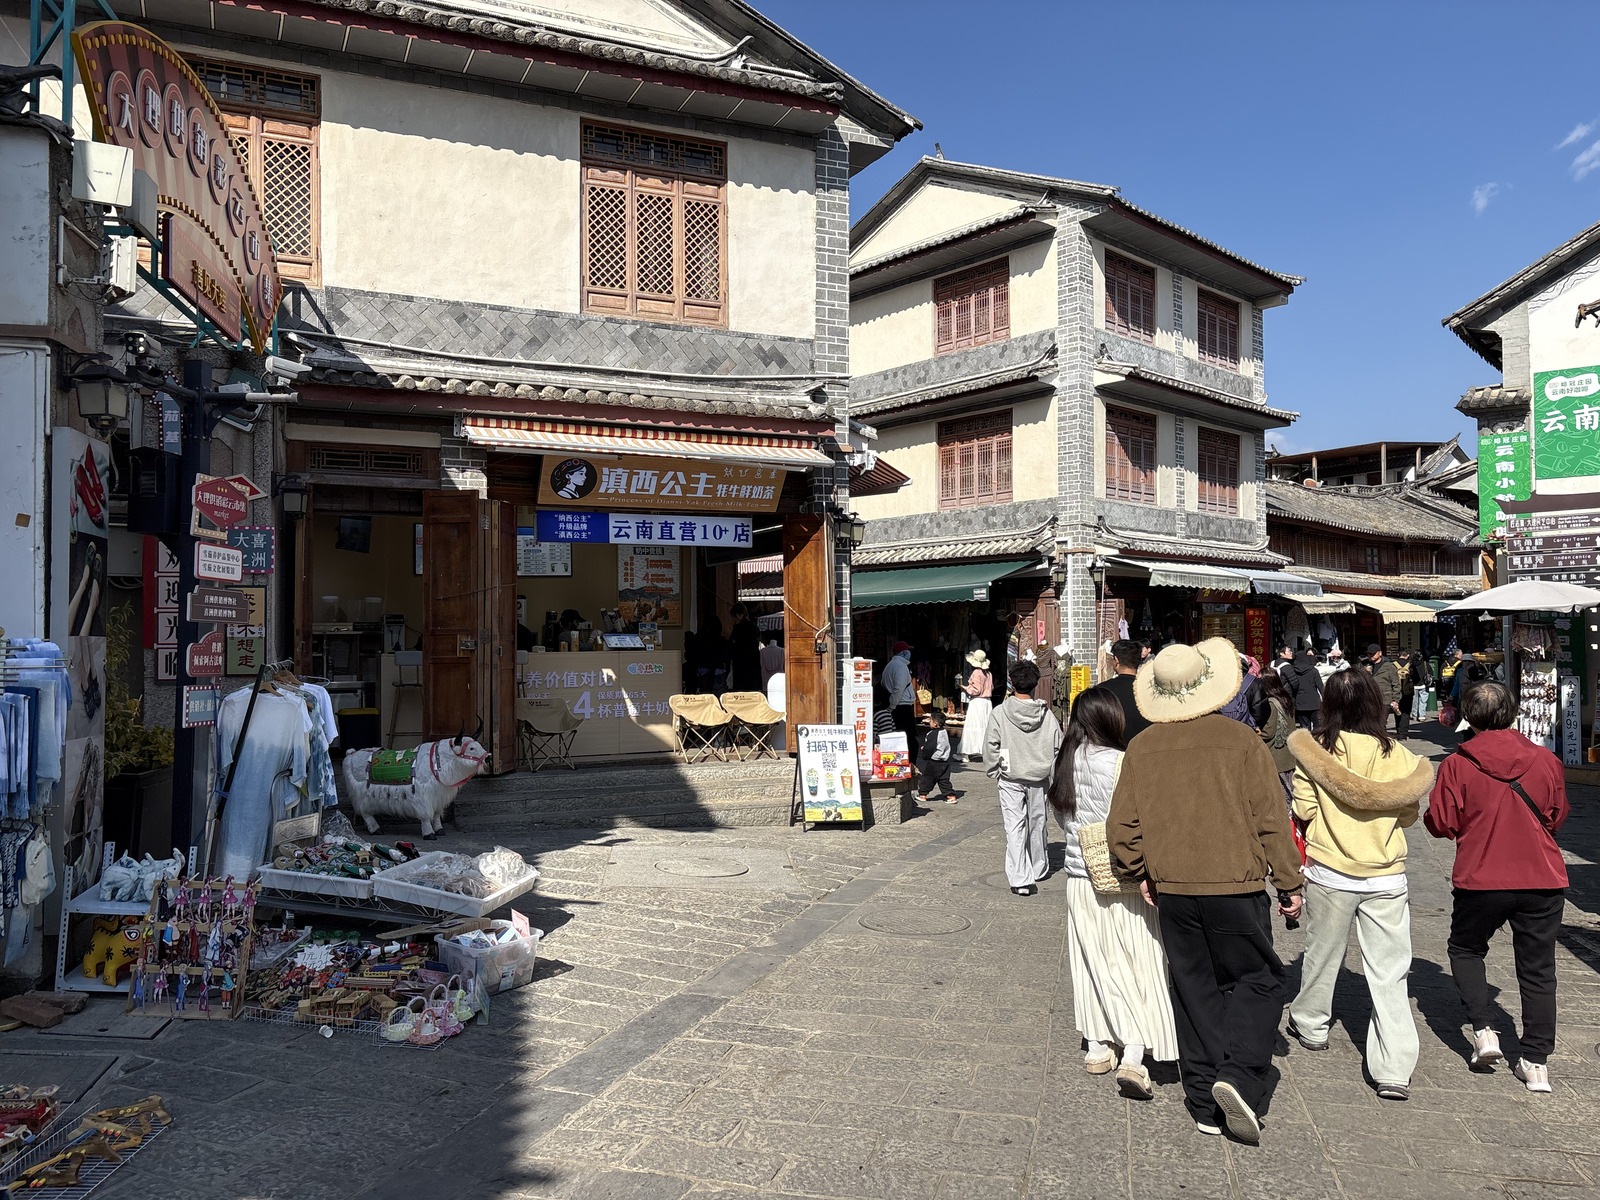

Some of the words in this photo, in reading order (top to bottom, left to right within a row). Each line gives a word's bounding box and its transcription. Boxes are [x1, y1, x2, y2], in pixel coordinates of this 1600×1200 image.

[115, 84, 275, 309] 大理供销彩云市集
[1541, 403, 1600, 433] 云南
[598, 467, 717, 498] 滇西公主
[716, 484, 776, 500] 牦牛鲜奶茶
[558, 523, 588, 531] 升级品牌
[234, 532, 267, 549] 大喜
[516, 671, 614, 689] 养价值对比
[573, 691, 595, 719] 4
[806, 740, 849, 753] 扫码下单
